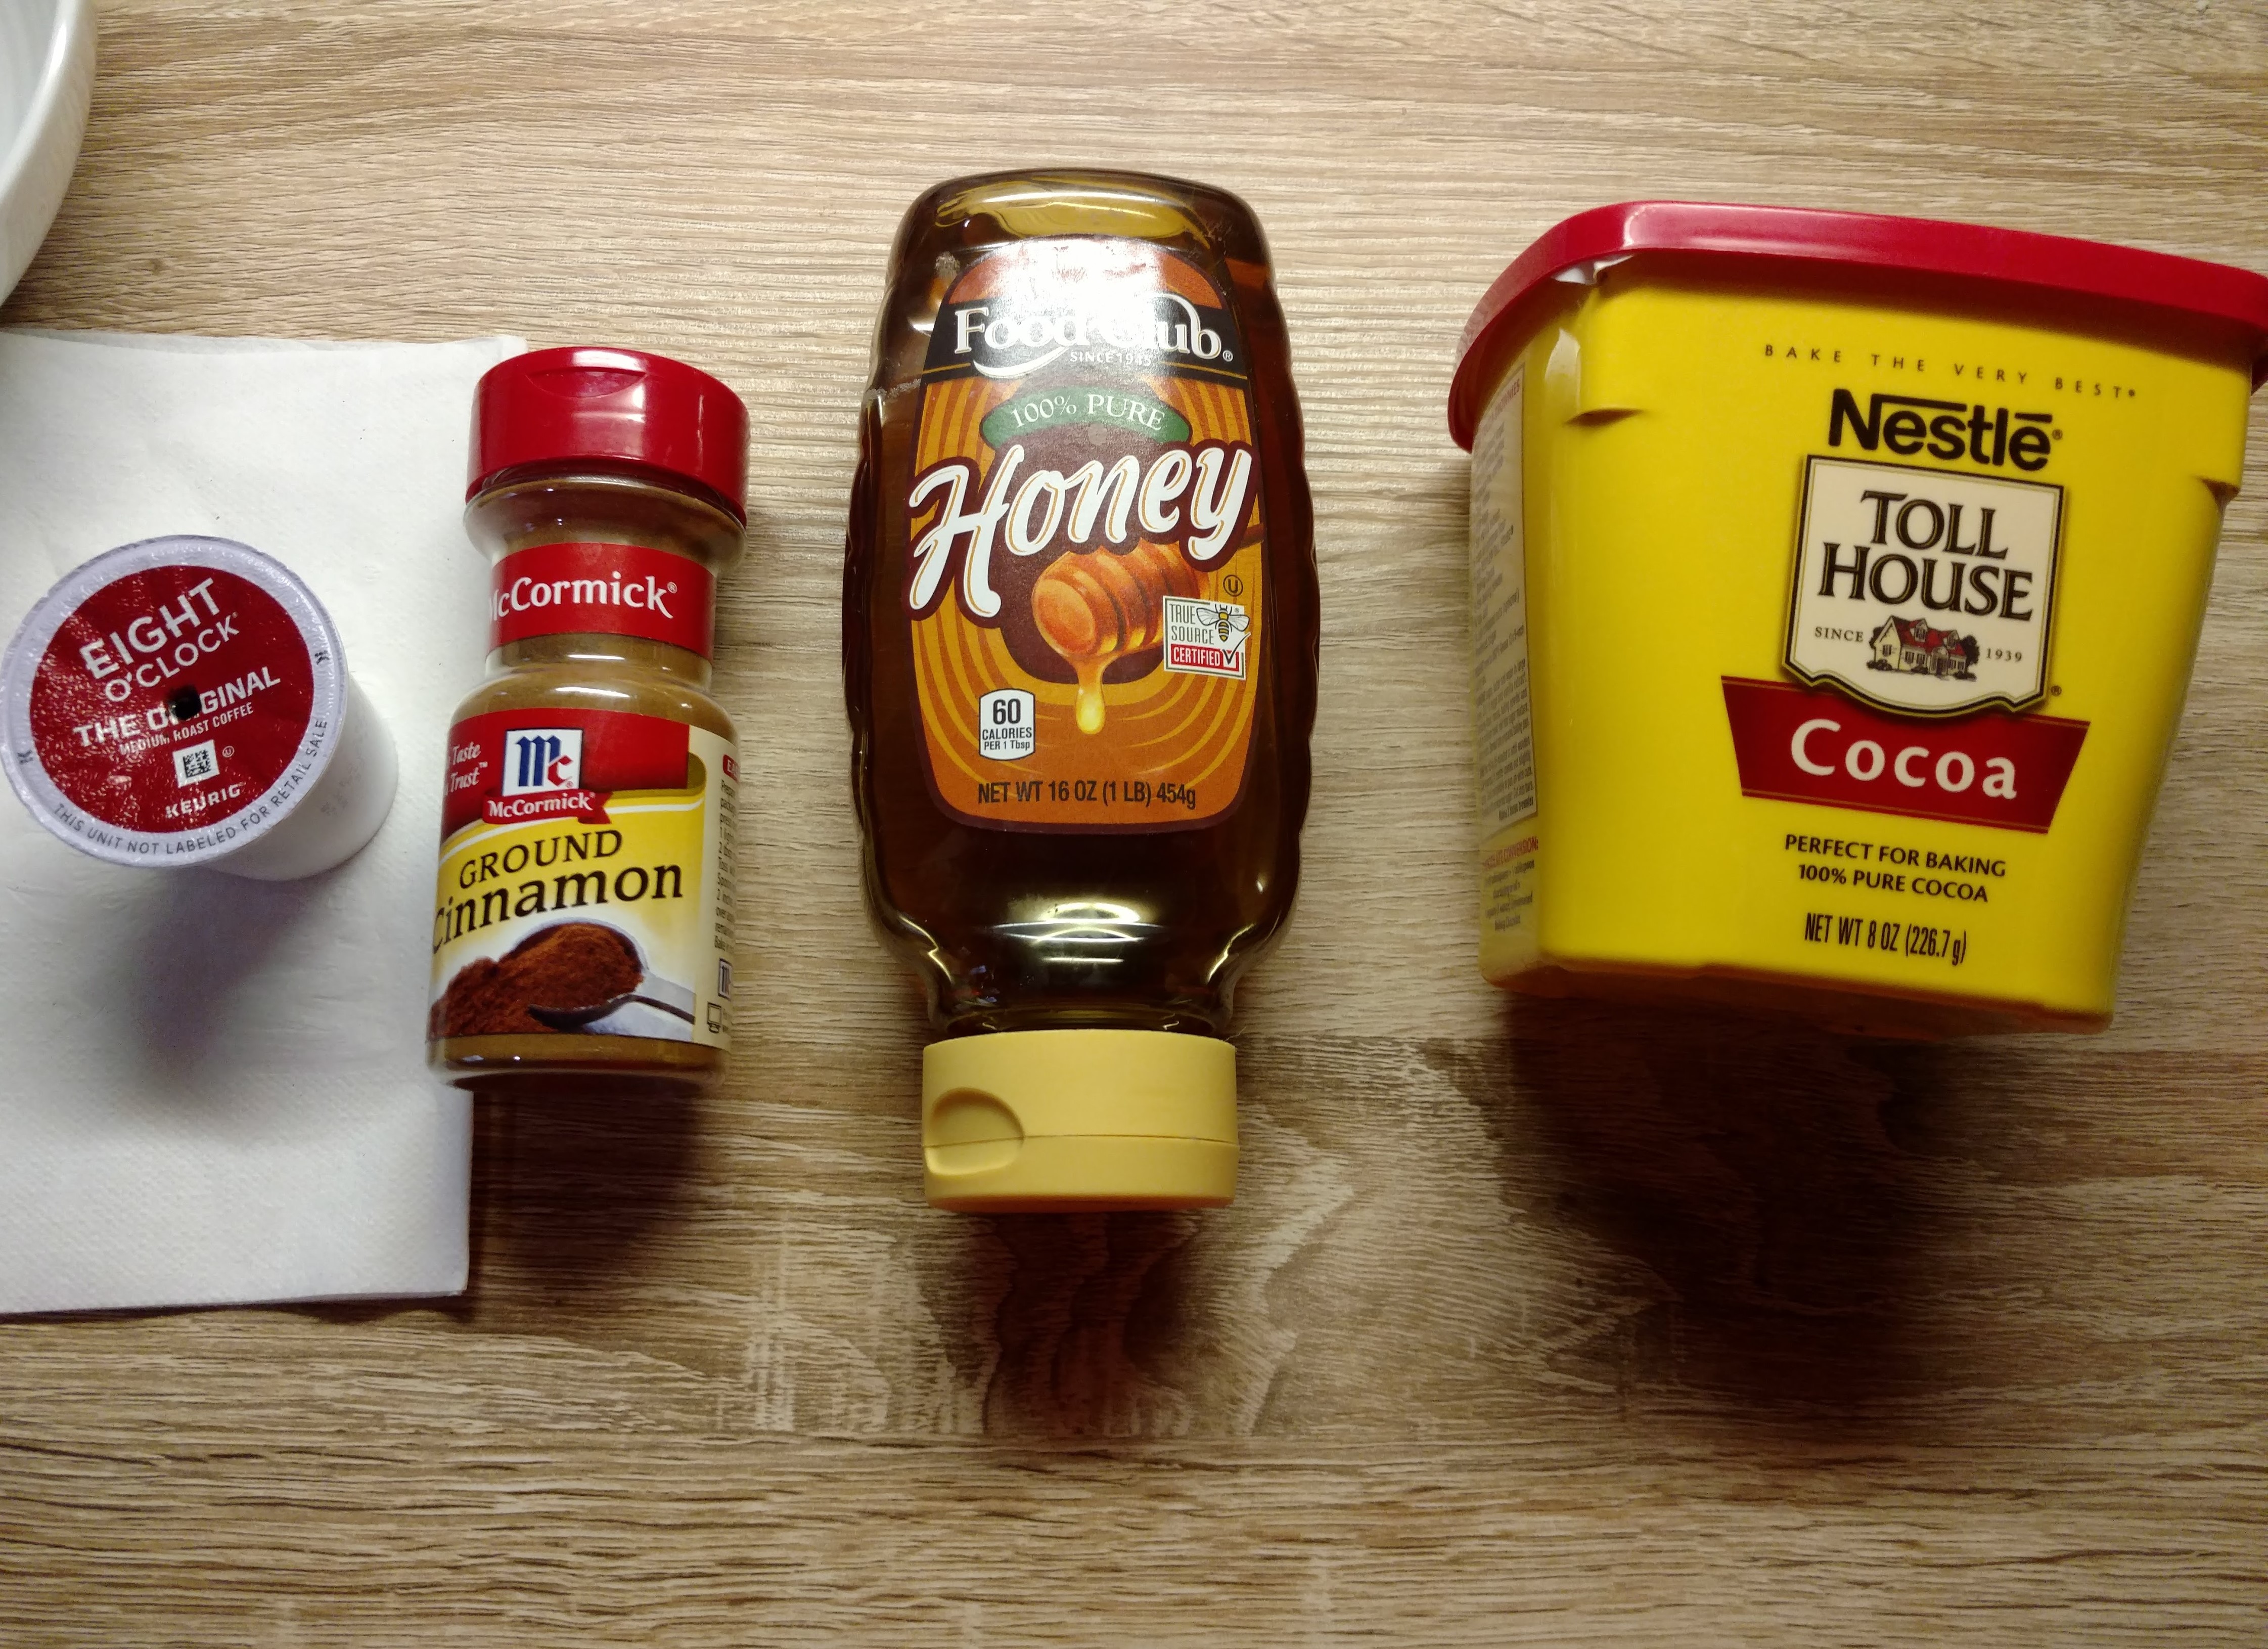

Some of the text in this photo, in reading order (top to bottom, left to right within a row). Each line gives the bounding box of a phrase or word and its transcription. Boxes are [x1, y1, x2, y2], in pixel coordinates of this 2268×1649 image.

[1069, 351, 1114, 364] SINCE
[1765, 344, 1841, 363] BAKE
[1871, 353, 1925, 372] THE
[1954, 363, 2027, 384] VERY
[1011, 393, 1165, 431] 100% PURE
[910, 444, 1252, 618] Honey
[1860, 489, 2009, 560] TOLL
[1818, 542, 2033, 622] HOUSE
[79, 577, 220, 680] EIGHT
[1169, 603, 1196, 625] TRUE
[1171, 625, 1214, 645] SOURCE
[1815, 626, 2022, 662] SINCE 1939
[105, 615, 240, 702] O'CLOCK
[1173, 647, 1220, 666] CERTIFIED
[72, 666, 281, 747] THE OGINAL
[993, 698, 1021, 725] 60
[119, 702, 254, 755] MEDIUM ROAST COFFEE
[982, 727, 1032, 740] CALORIES
[984, 740, 1030, 751] PER 1 Tbsp
[452, 741, 481, 765] Taste
[1790, 718, 2017, 800] Cocoa
[54, 720, 327, 855] THIS UNIT NOT LABELED FOR RETAIL SALE
[449, 767, 480, 793] Trust
[978, 780, 1196, 809] NET WT 16 OZ (1 LB) 454g
[165, 783, 242, 819] KEURIG
[487, 792, 594, 818] McCormick
[459, 829, 623, 889] GROUND
[1785, 833, 2006, 877] PERFECT FOR BAKING
[1798, 863, 1988, 903] 100% PURE COCOA
[433, 864, 683, 955] Cinnamon
[1804, 912, 1967, 966] NET WT 8 OZ (226.7 g)
